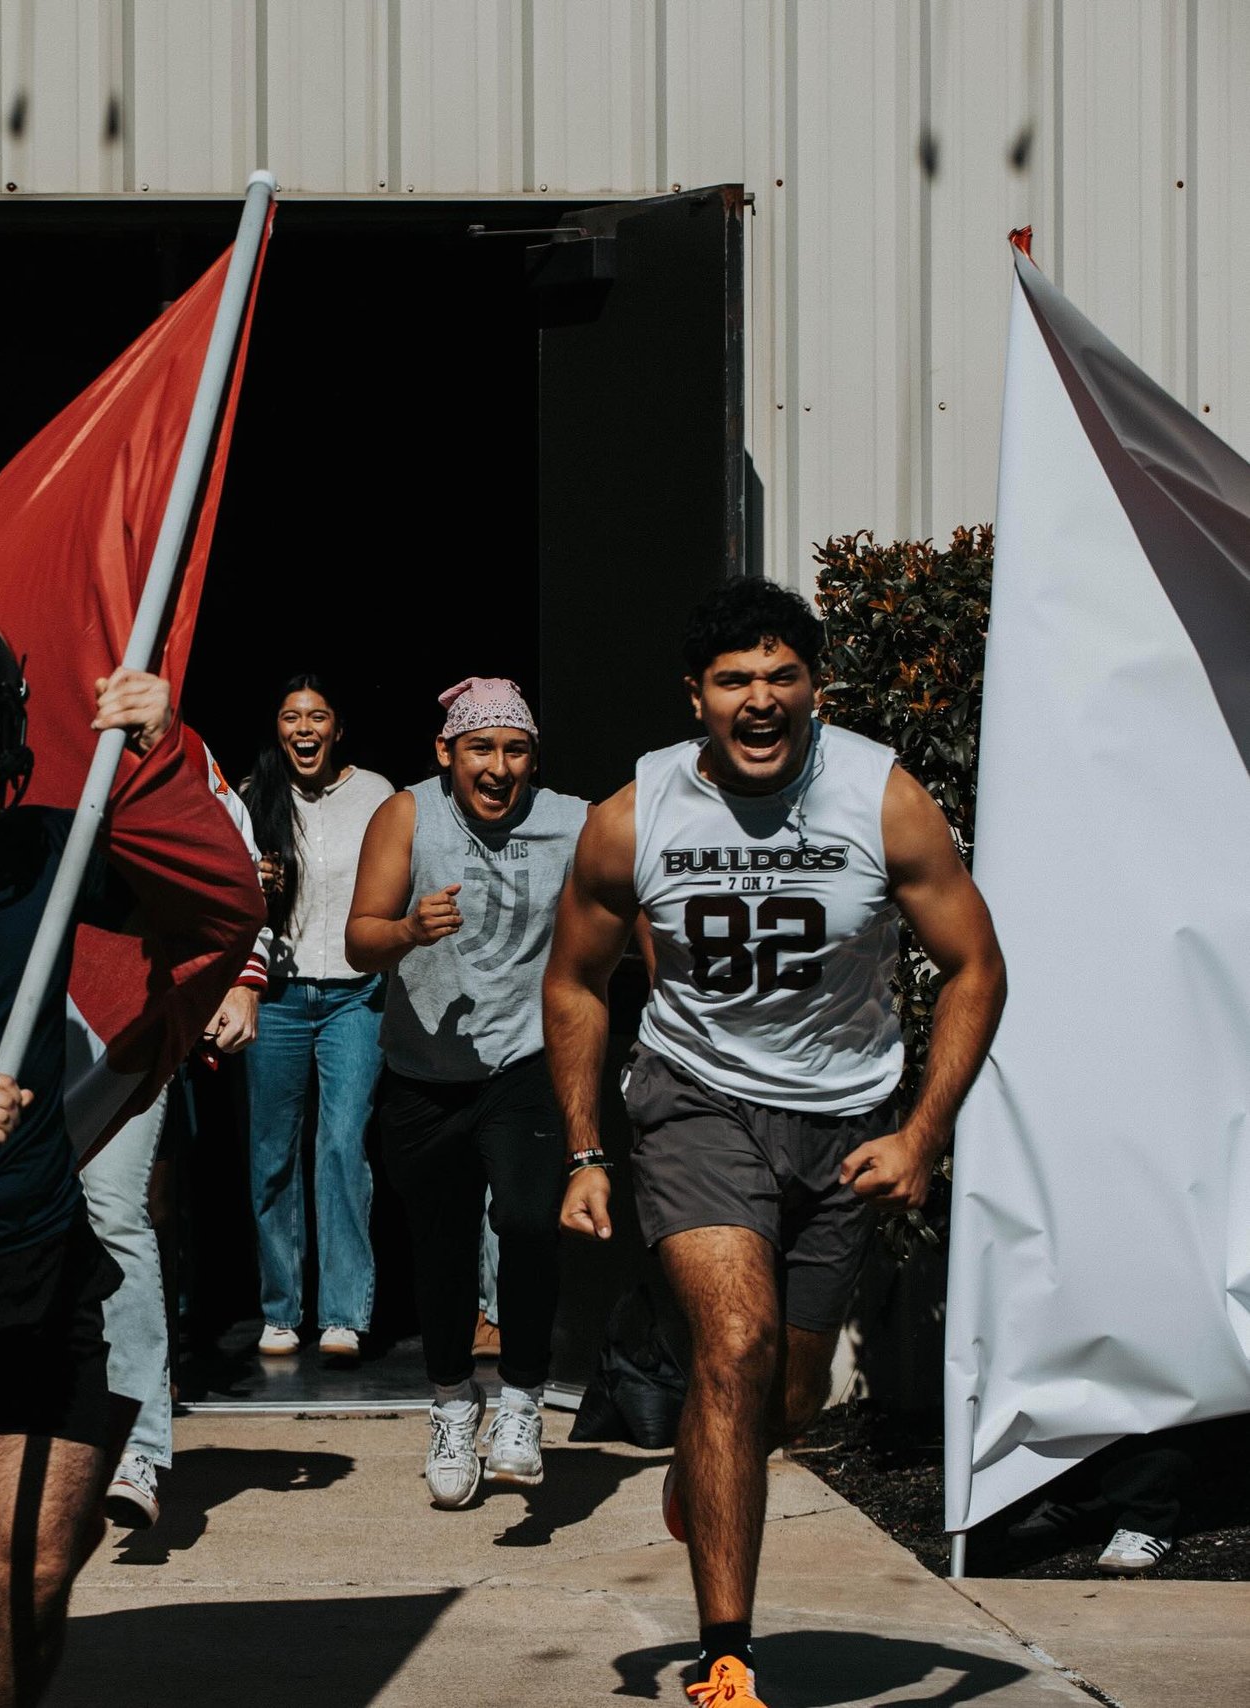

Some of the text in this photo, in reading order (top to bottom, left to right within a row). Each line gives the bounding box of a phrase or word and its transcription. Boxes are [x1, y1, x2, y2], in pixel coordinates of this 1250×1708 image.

[661, 845, 850, 876] BULLDOGS
[728, 876, 775, 890] 7 ON 7
[685, 896, 826, 994] 82
